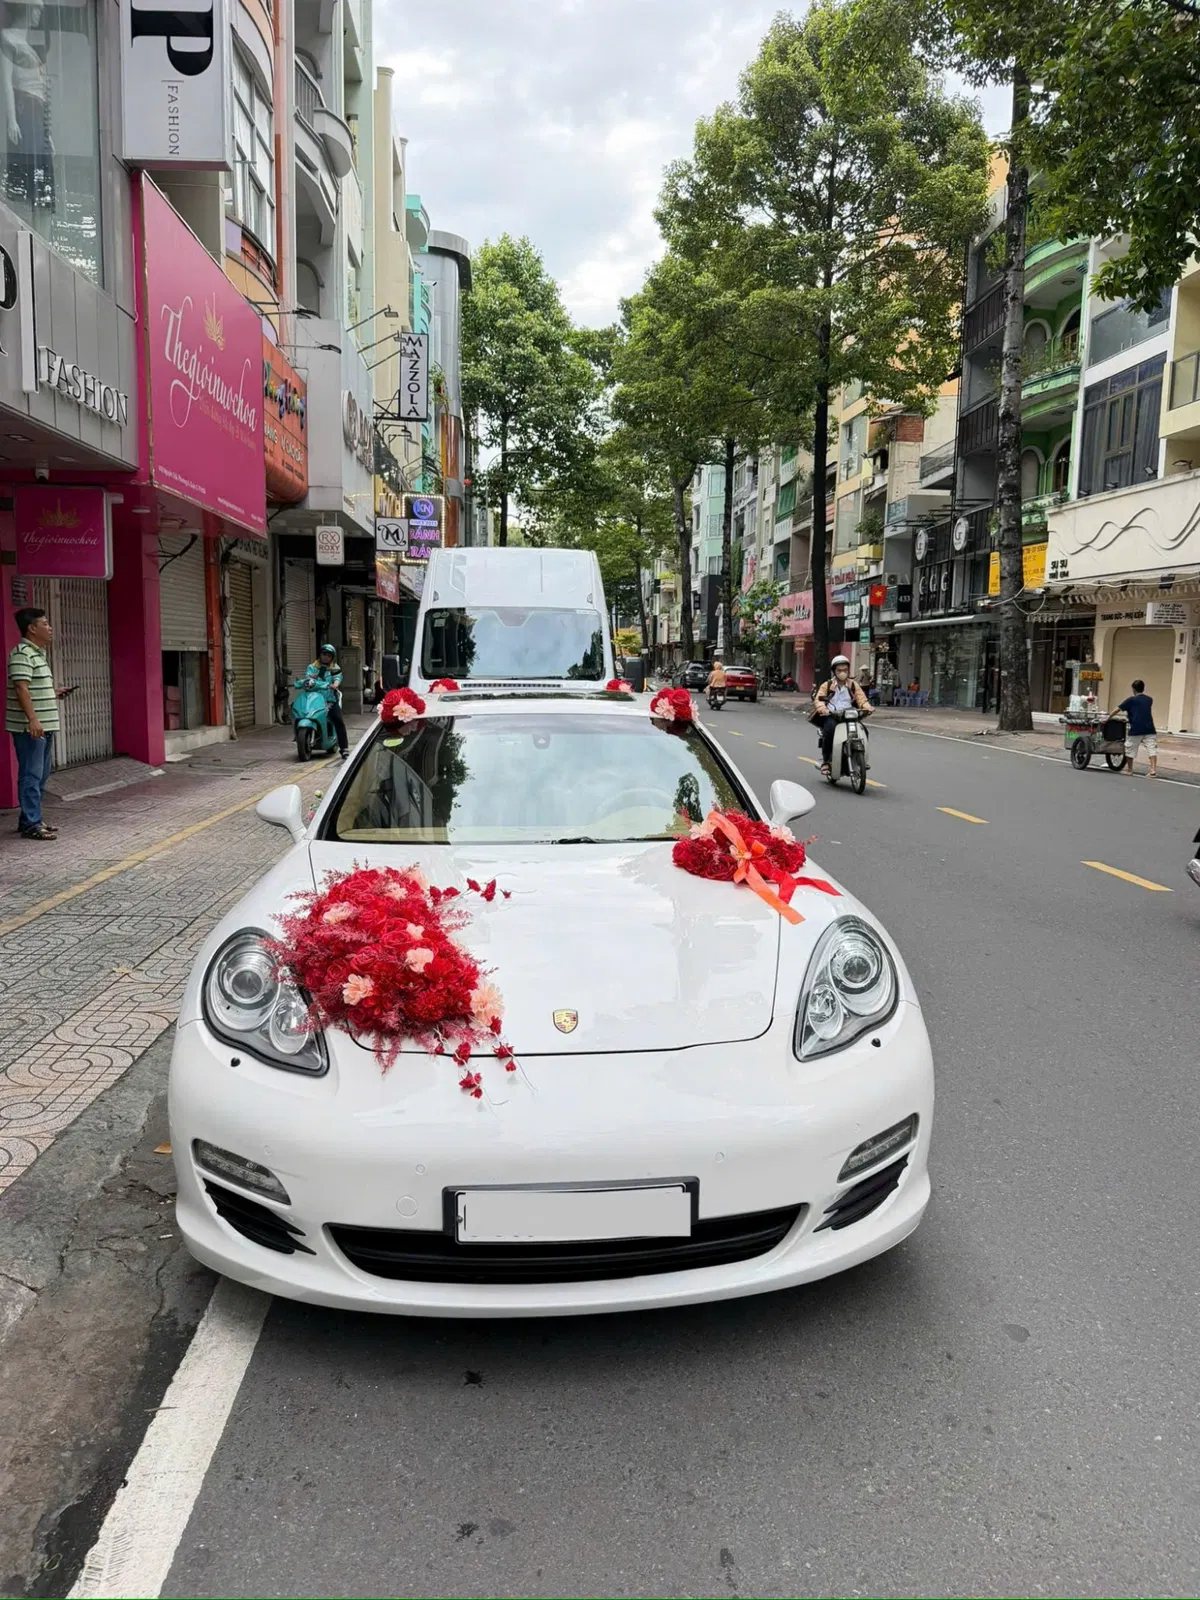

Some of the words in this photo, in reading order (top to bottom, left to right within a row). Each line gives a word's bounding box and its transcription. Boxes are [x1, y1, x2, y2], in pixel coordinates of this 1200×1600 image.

[168, 85, 180, 156] FASHION
[38, 345, 129, 426] FASHION
[161, 296, 258, 432] Thegioinuochoa
[406, 336, 423, 412] MAZZOLA
